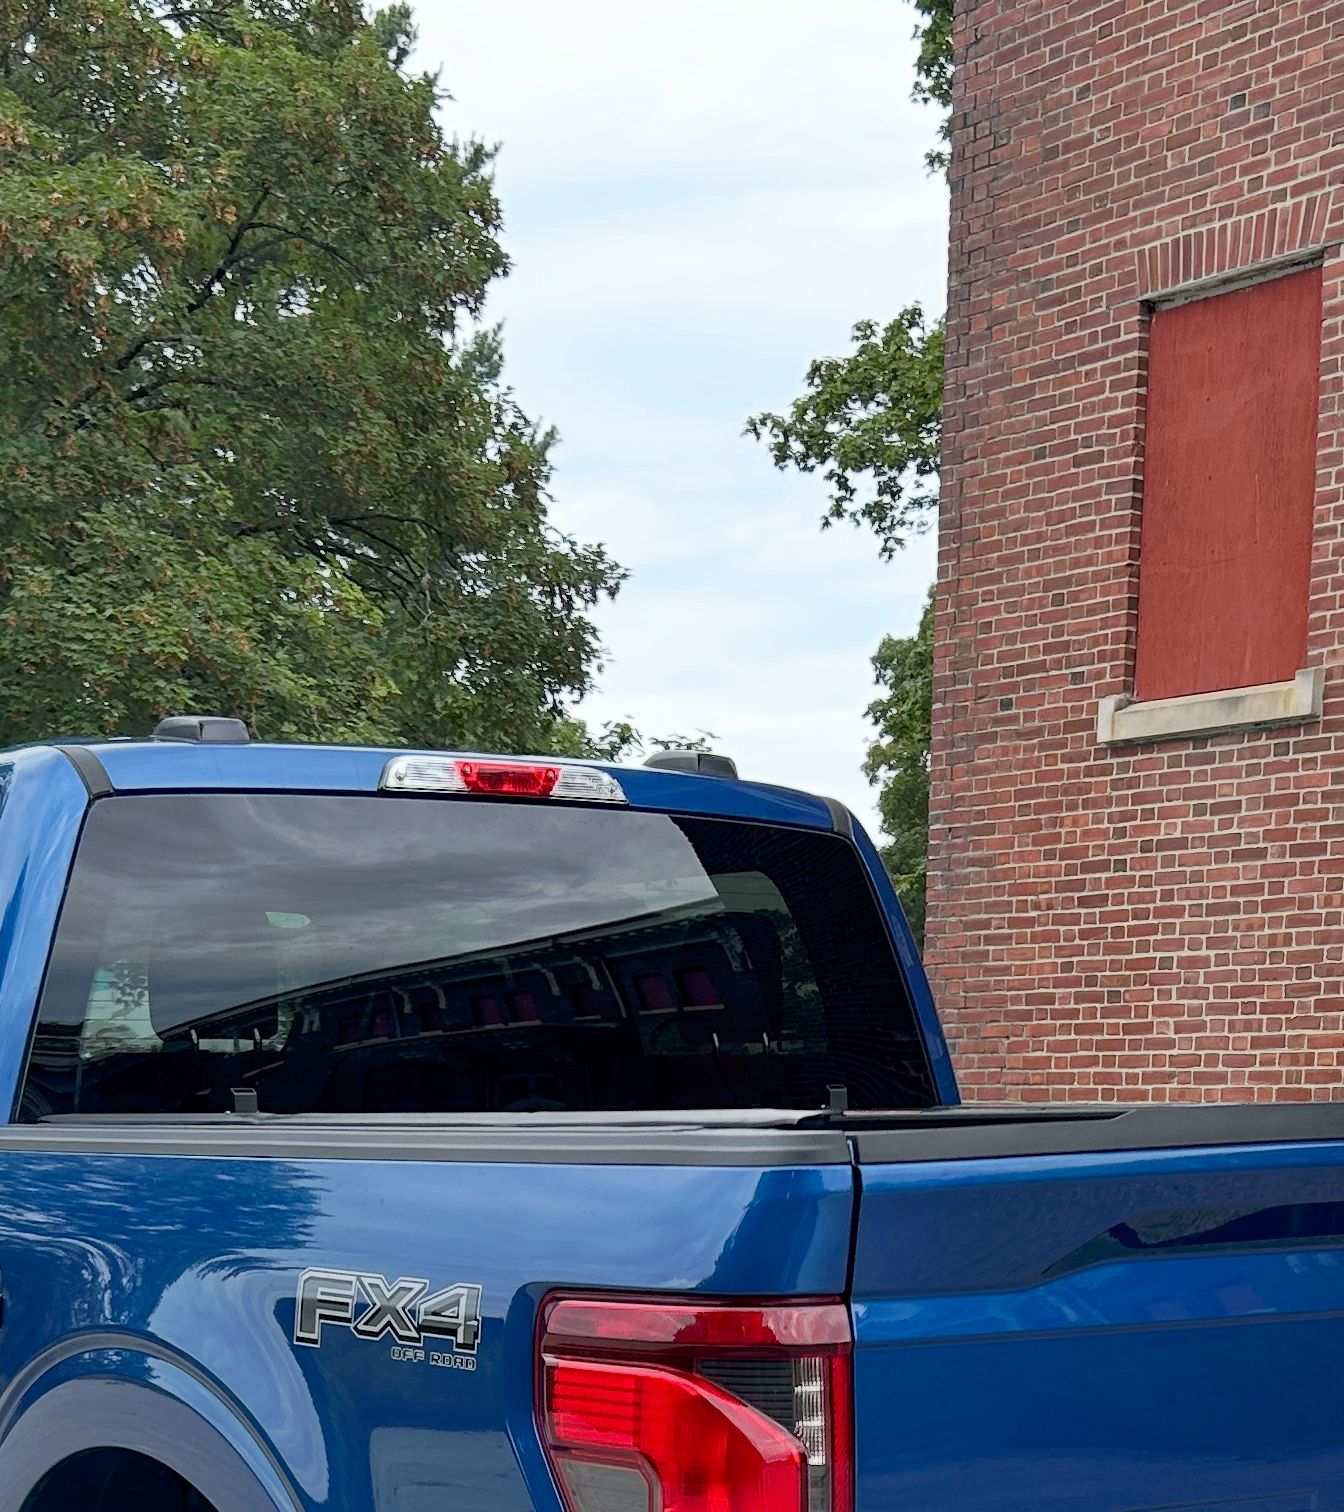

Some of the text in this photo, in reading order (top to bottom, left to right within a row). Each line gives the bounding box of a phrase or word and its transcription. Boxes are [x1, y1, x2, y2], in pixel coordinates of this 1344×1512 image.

[294, 1267, 483, 1354] FX4
[391, 1346, 477, 1371] OFF ROAD
